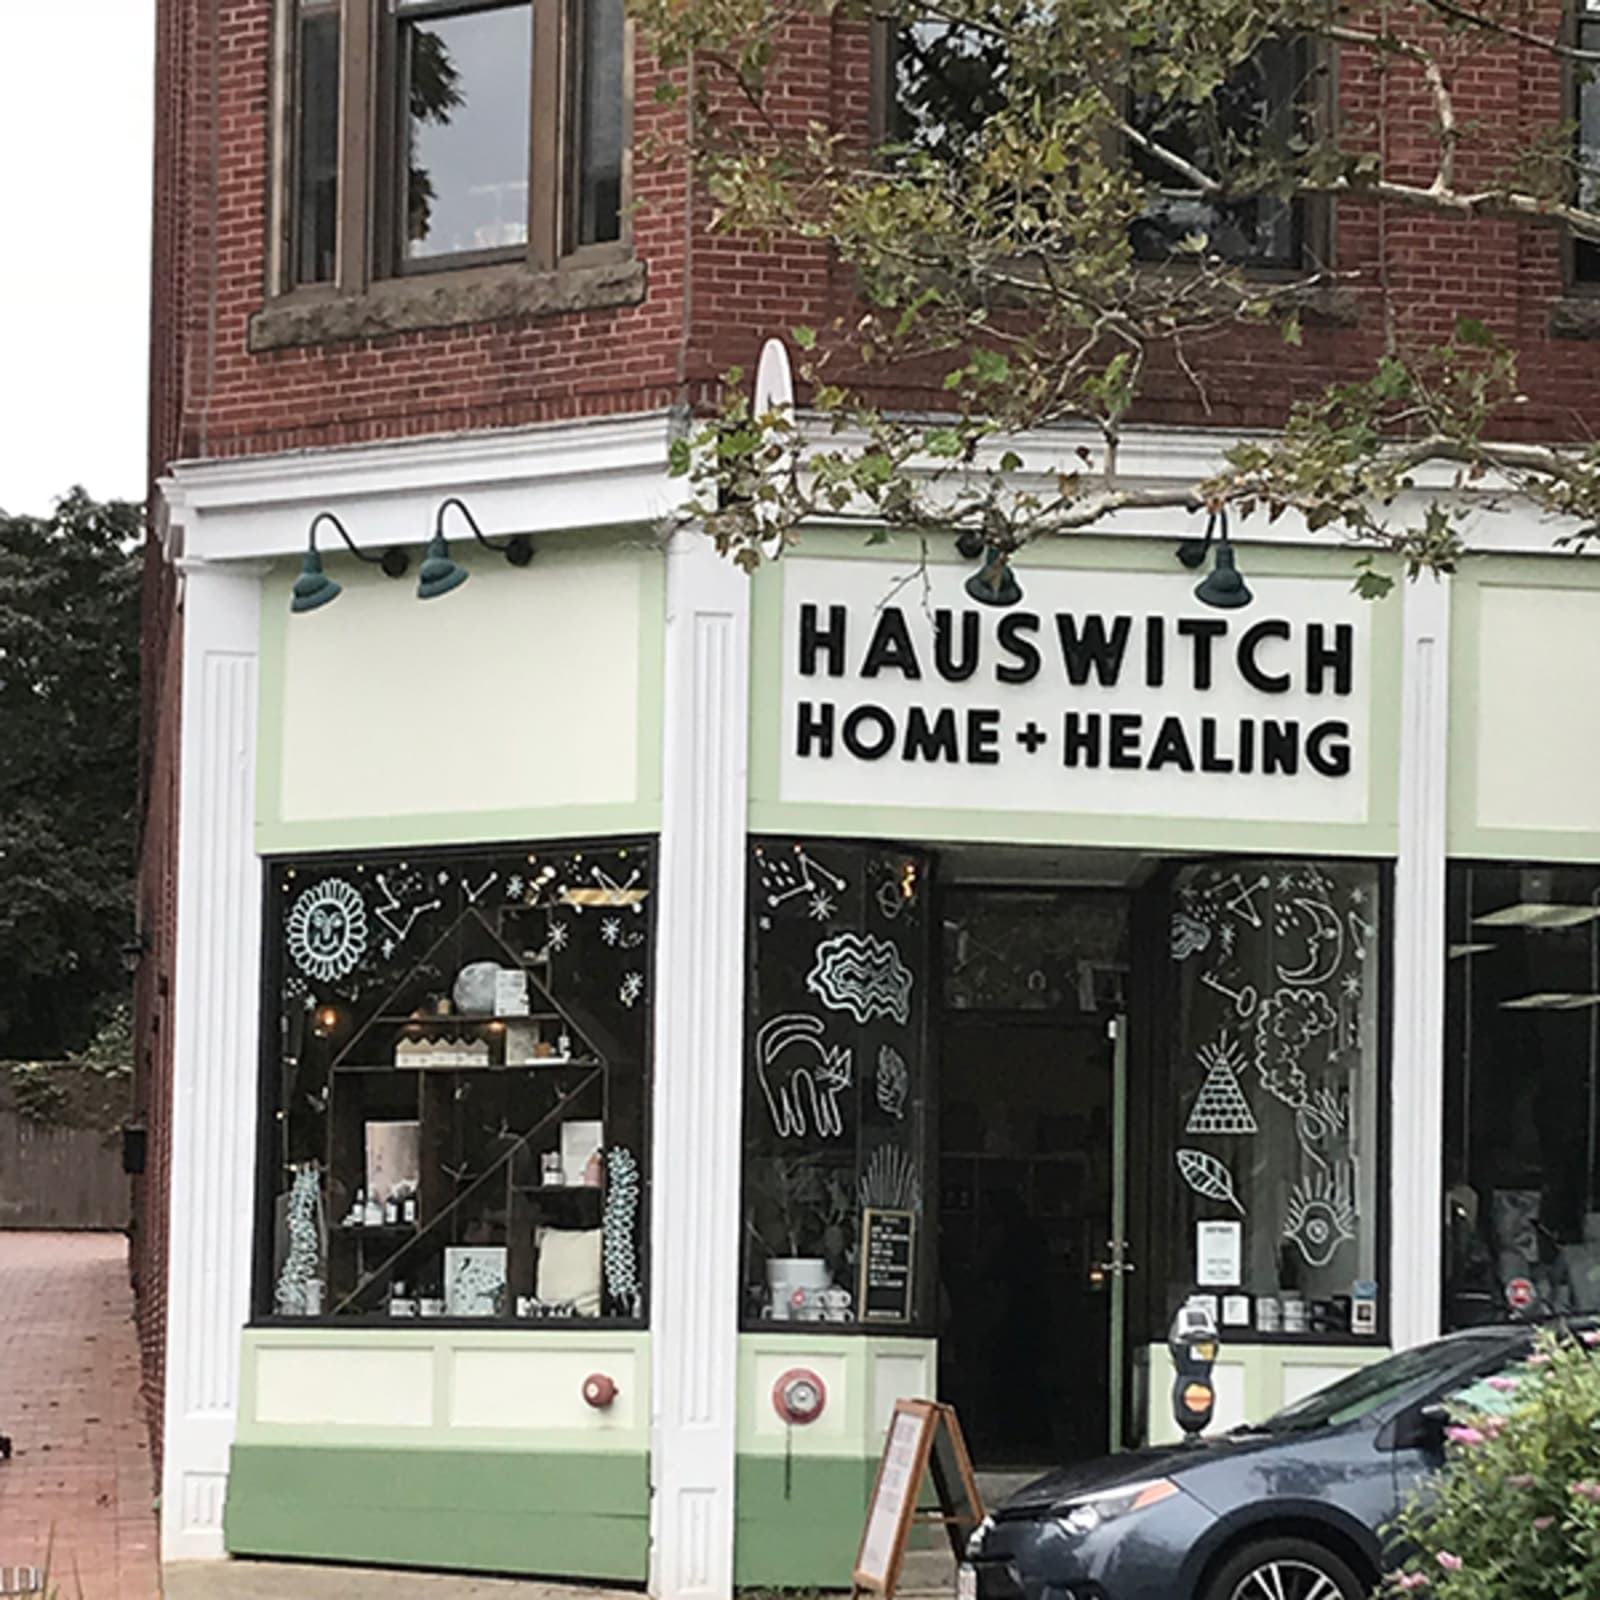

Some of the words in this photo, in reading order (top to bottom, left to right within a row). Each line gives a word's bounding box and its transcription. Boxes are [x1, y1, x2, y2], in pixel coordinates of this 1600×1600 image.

[800, 603, 1353, 697] HAUSWITCH
[797, 702, 1001, 765] HOME
[1017, 723, 1047, 754] +
[1064, 712, 1351, 778] HEALING
